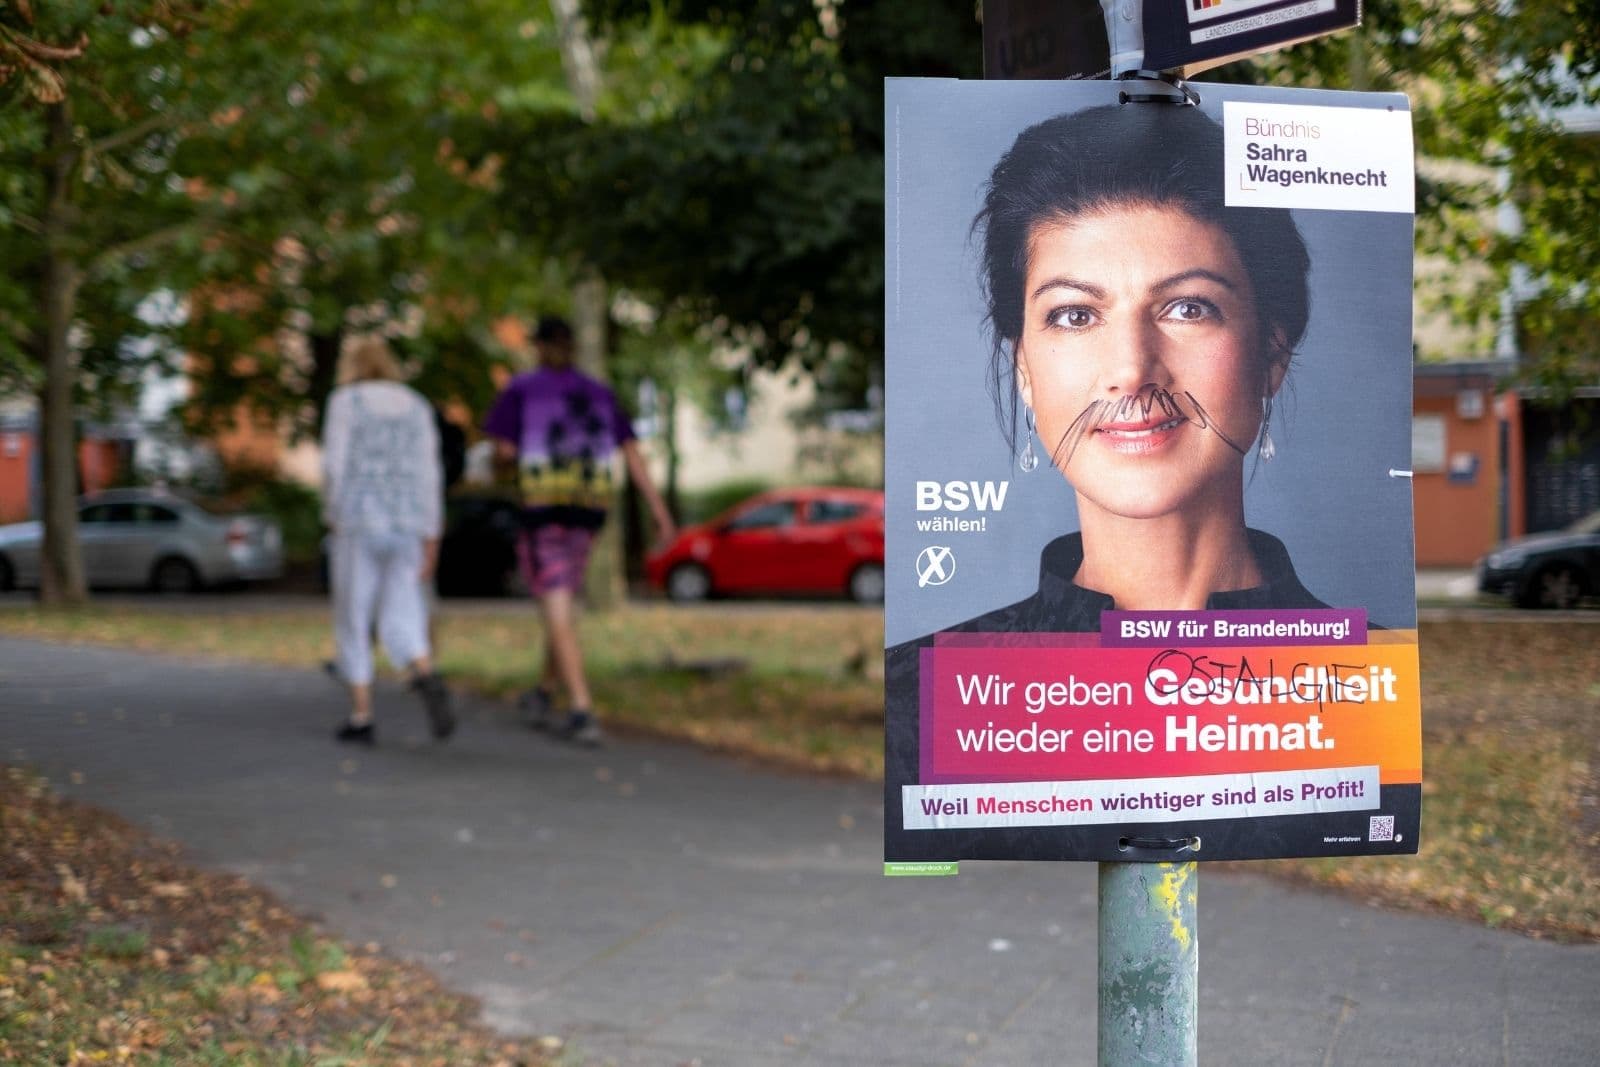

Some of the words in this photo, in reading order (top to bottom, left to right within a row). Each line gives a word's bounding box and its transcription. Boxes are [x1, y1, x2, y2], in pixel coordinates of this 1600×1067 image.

[1245, 118, 1321, 139] Bündnis
[1246, 142, 1307, 162] Sahra
[1246, 164, 1387, 187] Wagenknecht
[916, 480, 1009, 512] BSW
[916, 517, 986, 532] wählen!
[1120, 620, 1171, 638] BSW
[1178, 620, 1208, 638] für
[1214, 618, 1350, 639] Brandenburg!
[956, 674, 1015, 705] Wir
[1024, 675, 1132, 714] geben
[1144, 665, 1398, 706] Gesundheit
[1147, 649, 1367, 713] OSTALGIE
[956, 721, 1073, 752] wieder
[1082, 721, 1154, 752] eine
[1165, 715, 1335, 752] Heimat.
[921, 798, 968, 816] Weil
[976, 796, 1093, 815] Menschen
[1100, 791, 1205, 813] wichtiger
[1211, 787, 1257, 806] sind
[1263, 785, 1294, 803] als
[1301, 780, 1365, 801] Profit!
